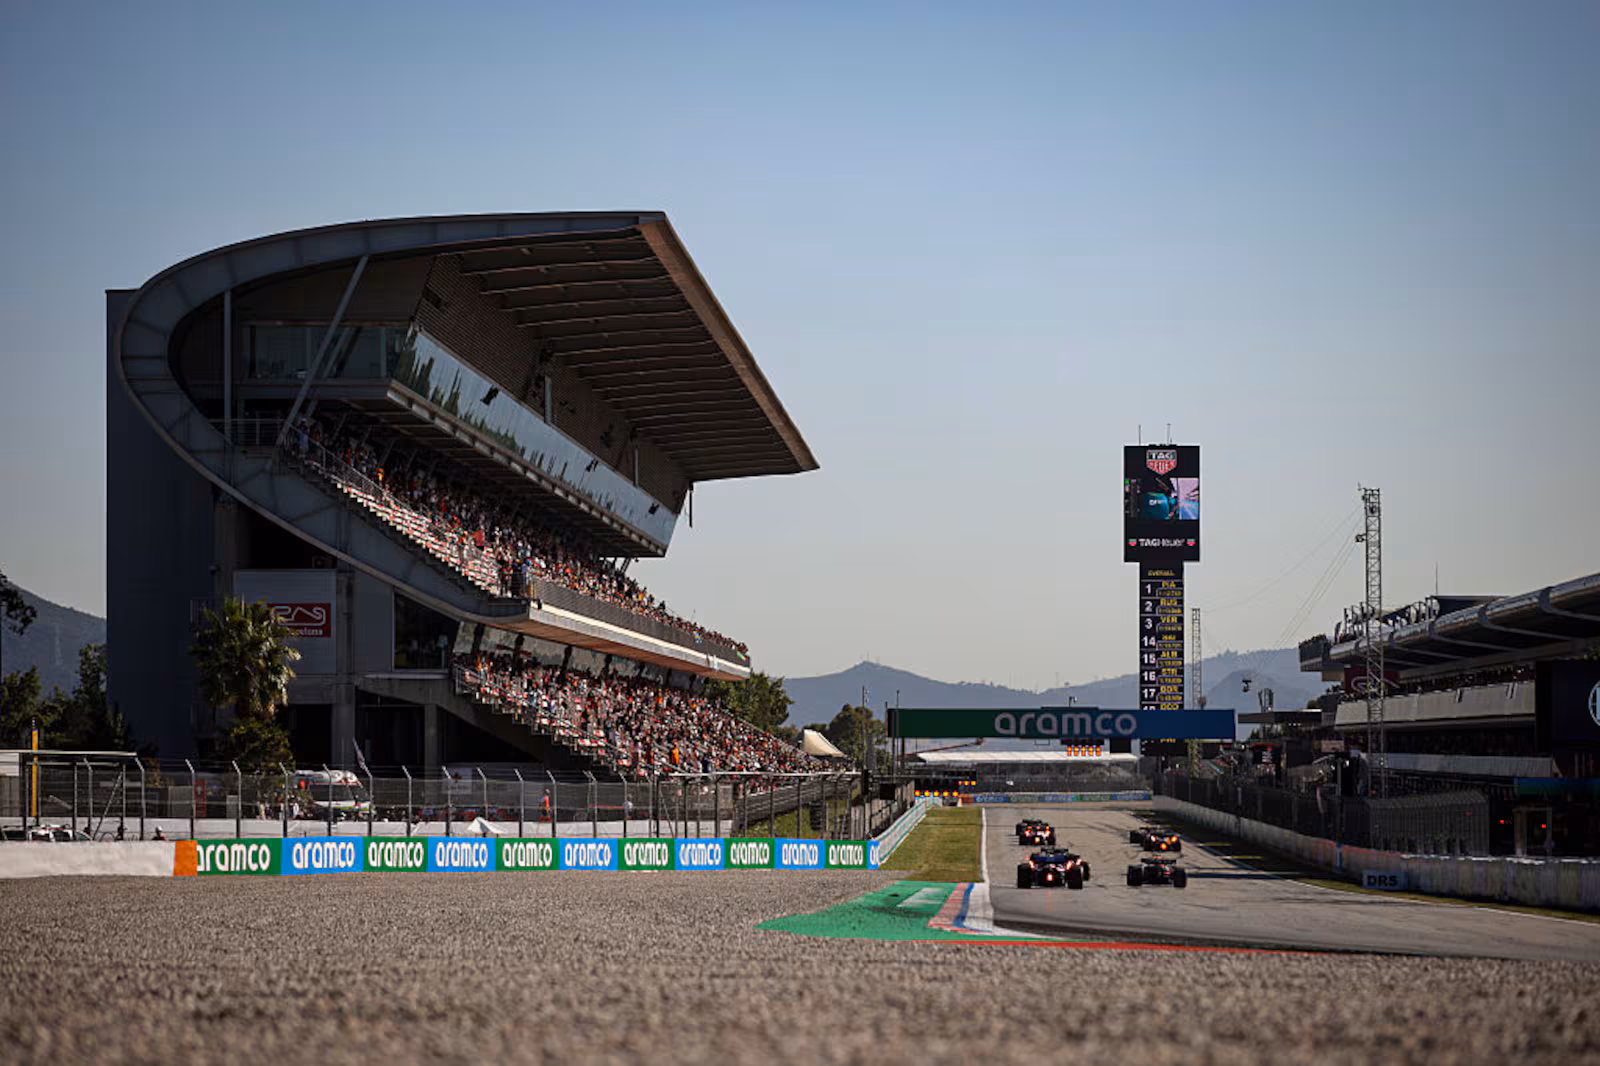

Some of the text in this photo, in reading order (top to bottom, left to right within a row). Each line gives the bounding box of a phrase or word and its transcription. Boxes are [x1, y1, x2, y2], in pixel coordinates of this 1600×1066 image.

[1145, 584, 1152, 594] 1
[1145, 601, 1152, 612] 2
[1145, 618, 1152, 629] 3
[1142, 635, 1155, 646] 14
[1142, 688, 1155, 698] 17
[994, 712, 1137, 735] aramco
[292, 842, 355, 869] aramco
[368, 841, 424, 868] aramco
[435, 841, 488, 867] aramco
[502, 842, 553, 867] aramco
[564, 842, 611, 867] aramco
[624, 842, 669, 867] aramco
[679, 842, 722, 867] aramco
[730, 841, 771, 866] aramco
[782, 842, 819, 866] aramco
[829, 844, 864, 866] aramco
[1367, 875, 1398, 887] DRS
